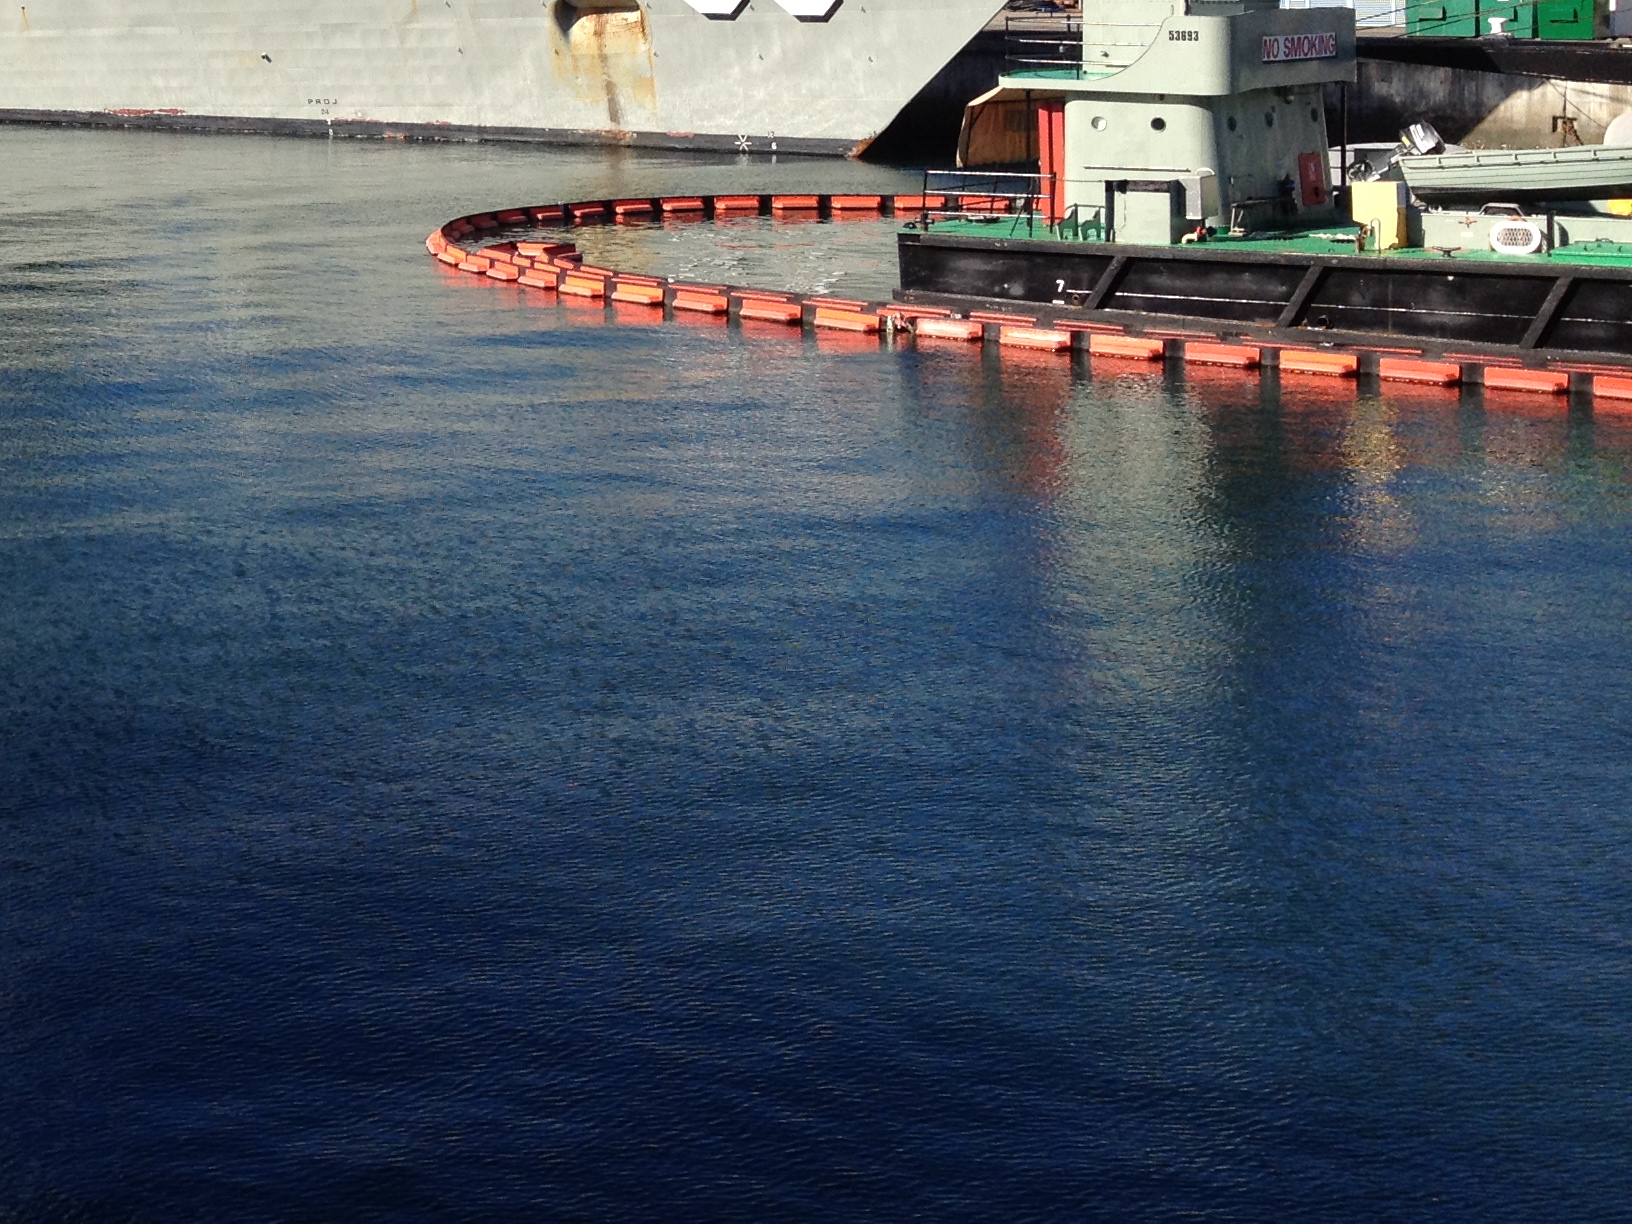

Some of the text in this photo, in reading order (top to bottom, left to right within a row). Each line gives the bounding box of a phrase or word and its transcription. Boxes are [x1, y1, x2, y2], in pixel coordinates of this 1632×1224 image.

[1168, 30, 1199, 42] 53693
[1263, 34, 1336, 59] NO SMOKING
[1055, 279, 1065, 293] 7
